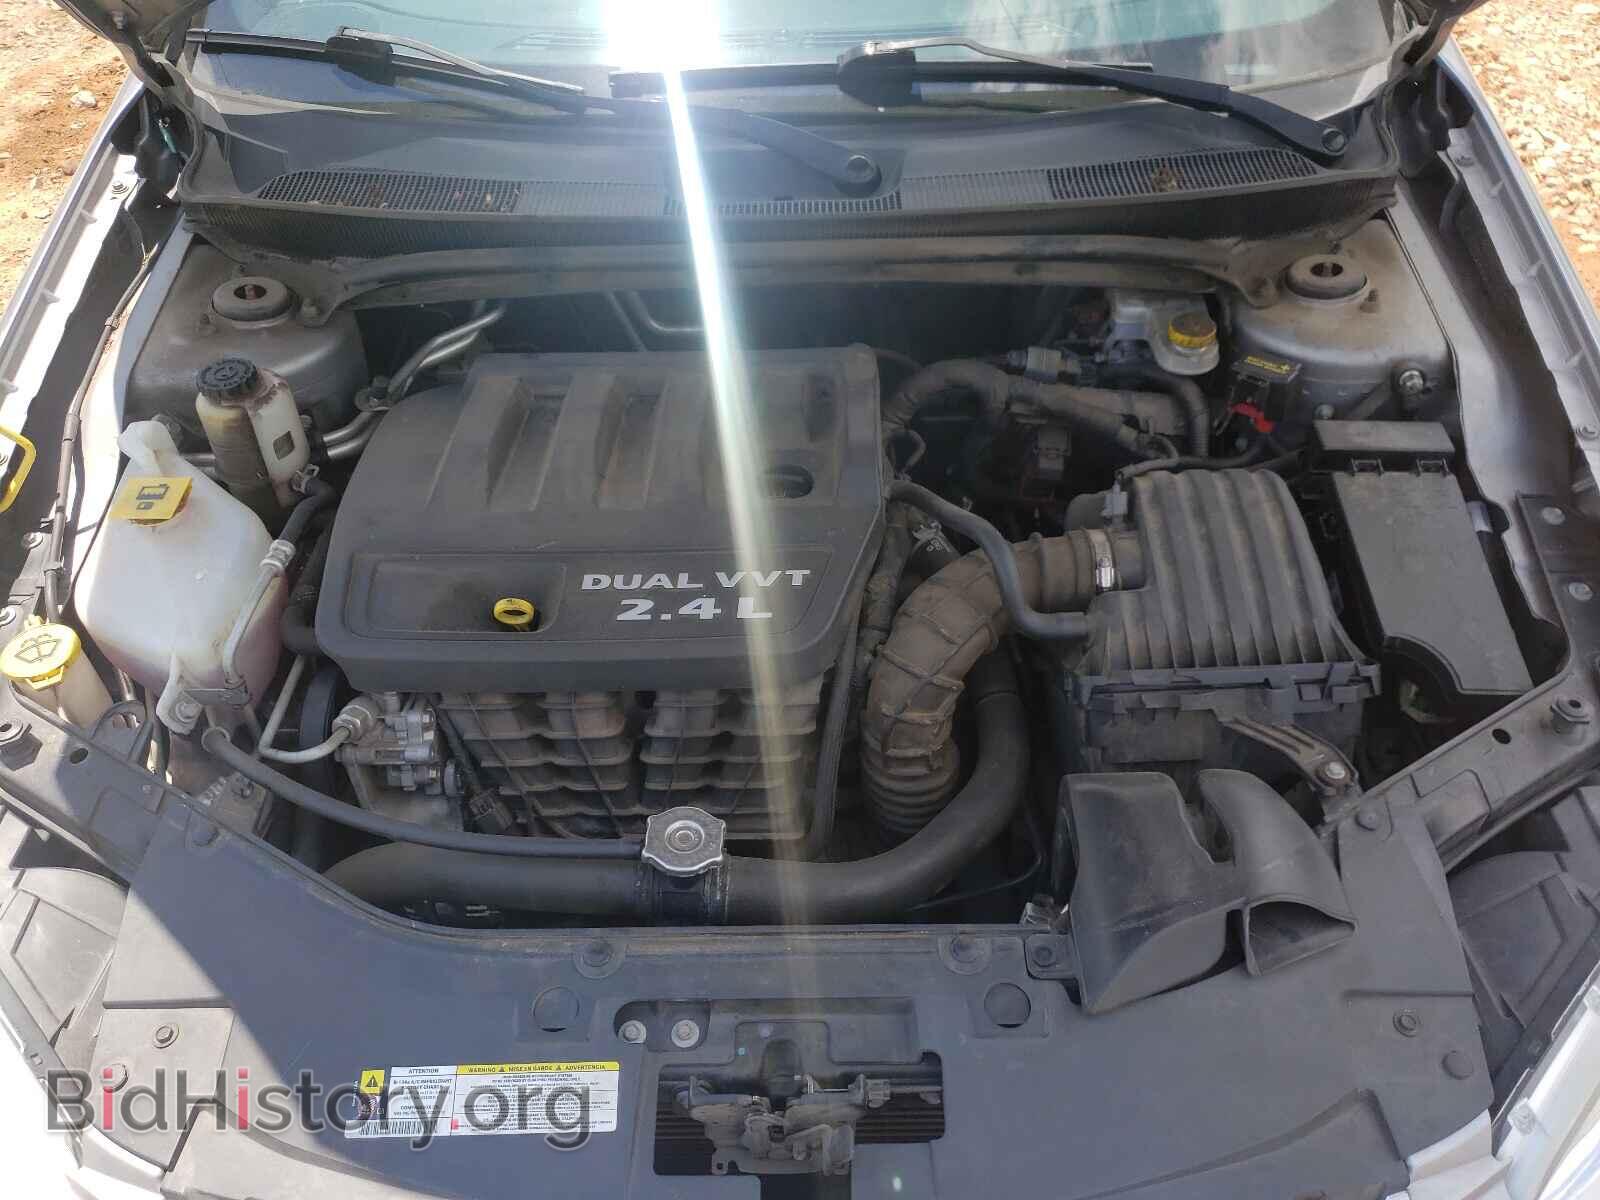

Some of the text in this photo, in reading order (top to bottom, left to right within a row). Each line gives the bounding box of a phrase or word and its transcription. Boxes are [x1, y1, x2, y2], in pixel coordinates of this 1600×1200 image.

[581, 569, 811, 590] DUAL VVT
[616, 597, 773, 621] 2.4 L
